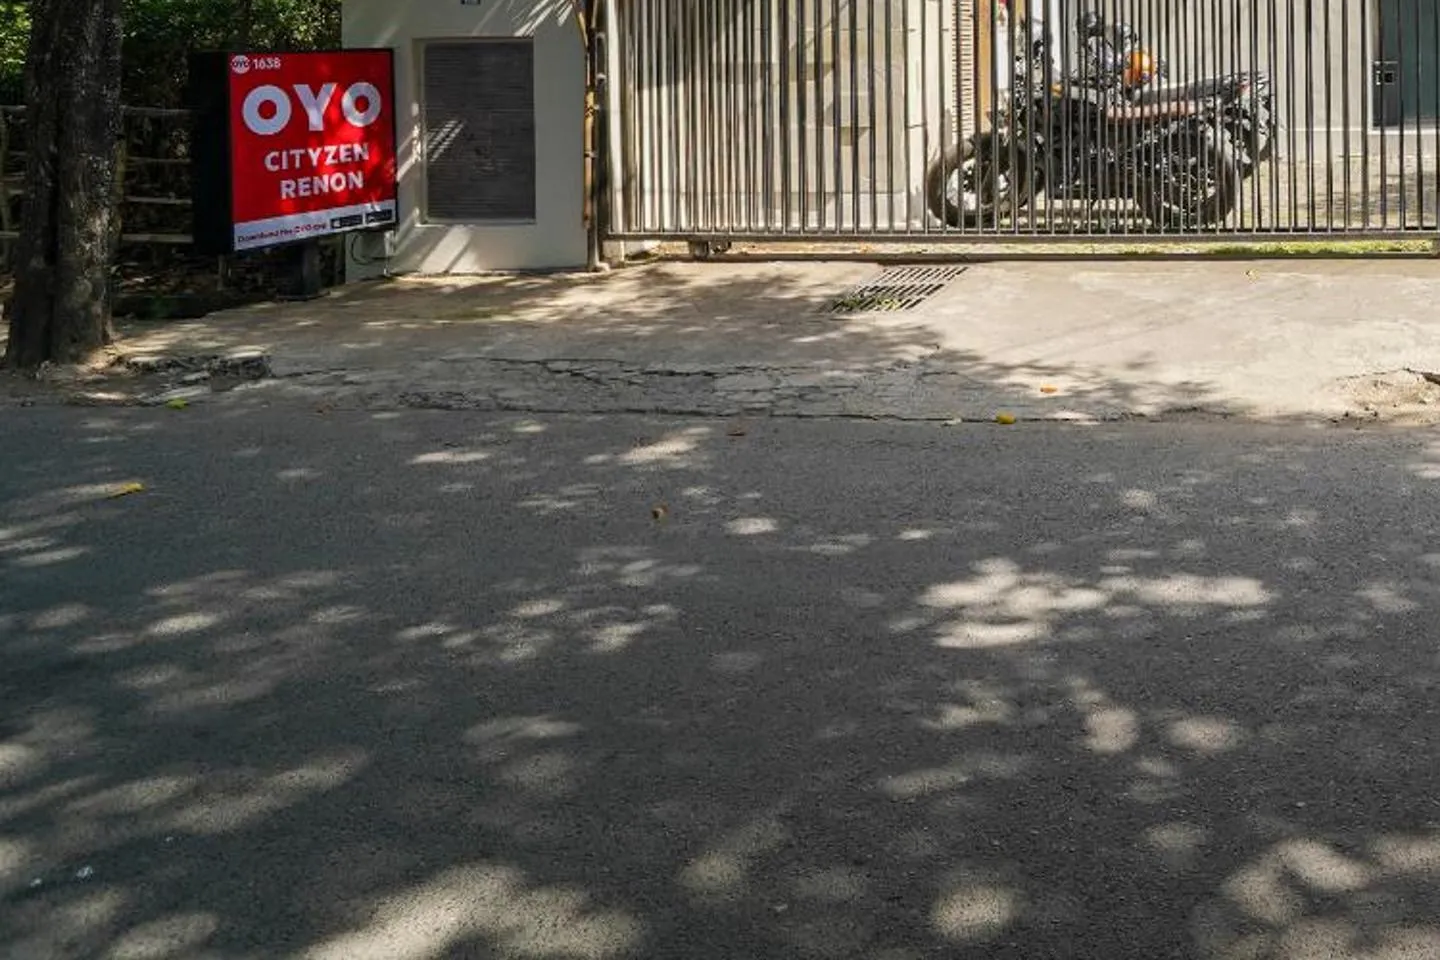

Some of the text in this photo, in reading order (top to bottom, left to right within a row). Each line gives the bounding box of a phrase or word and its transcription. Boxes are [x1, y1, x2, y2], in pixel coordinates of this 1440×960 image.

[243, 82, 381, 135] OYO
[264, 143, 369, 172] CITYZEN
[280, 172, 364, 200] RENON
